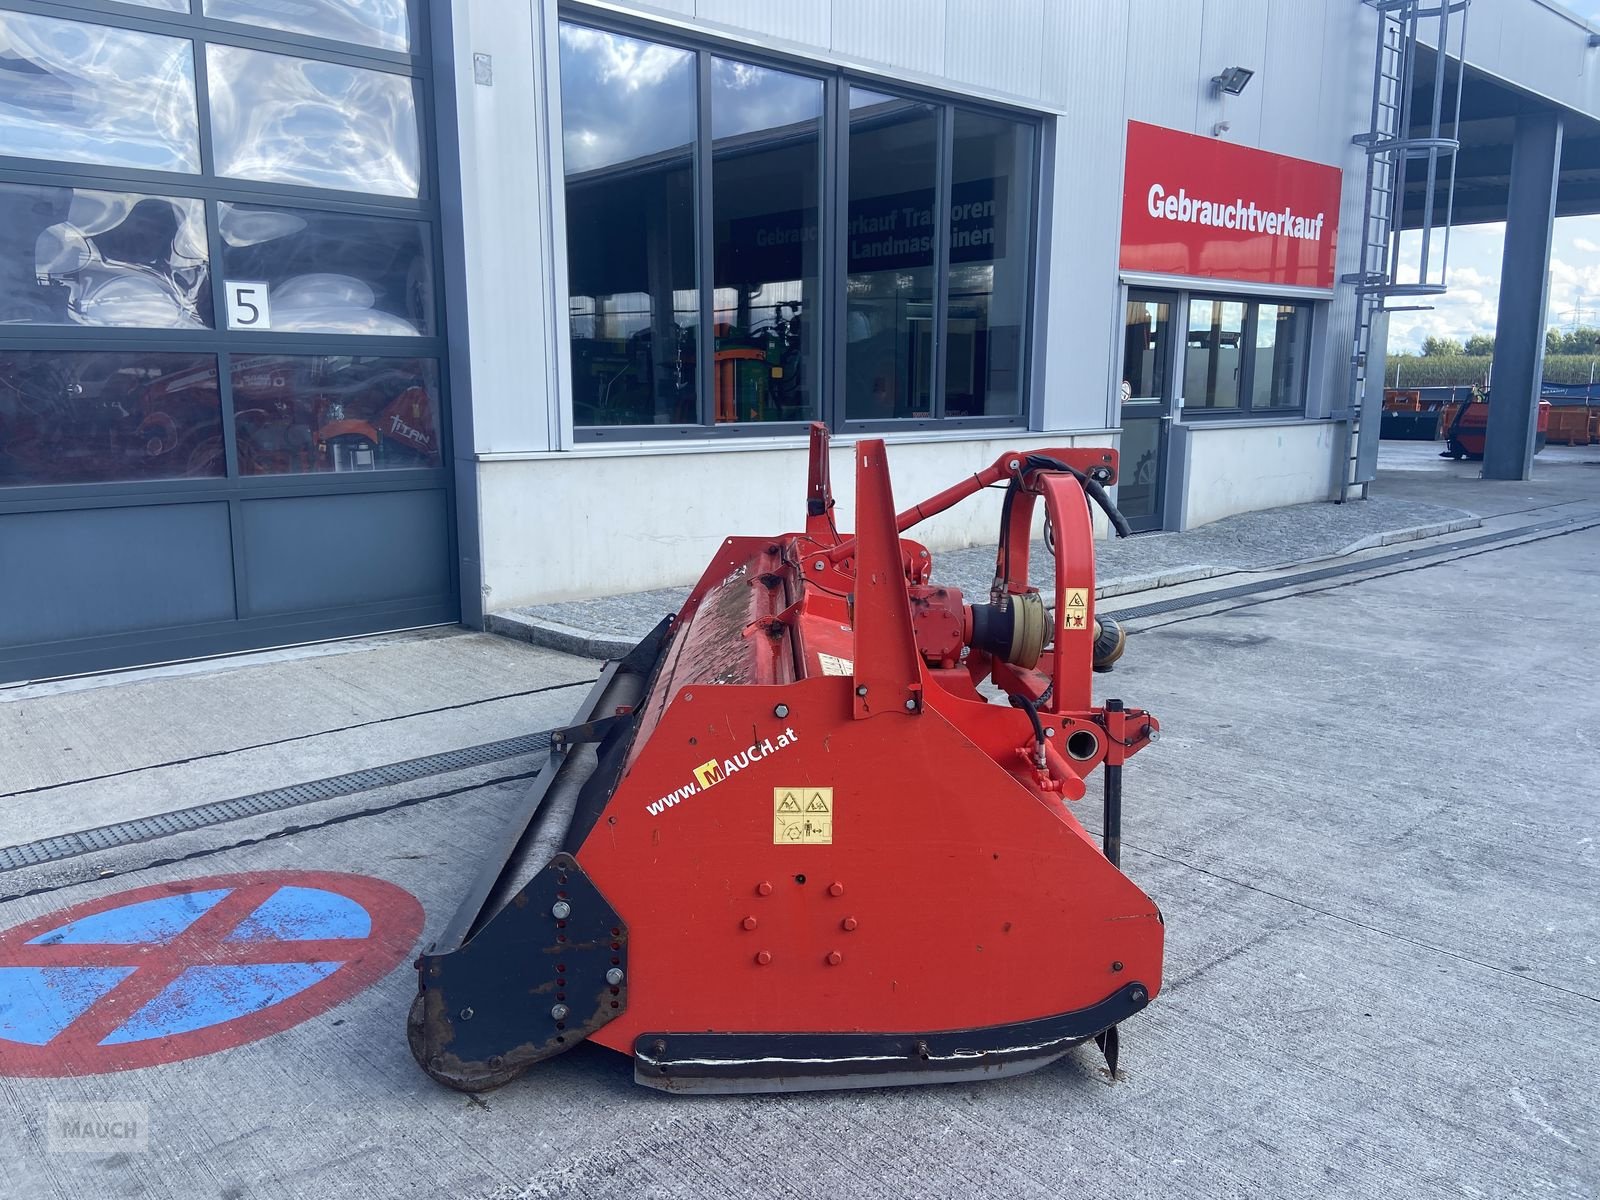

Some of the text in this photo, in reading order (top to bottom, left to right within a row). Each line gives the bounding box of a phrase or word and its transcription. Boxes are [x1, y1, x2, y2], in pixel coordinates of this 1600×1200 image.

[1147, 183, 1323, 240] Gebrauchtverkauf
[236, 289, 259, 324] 5
[645, 727, 799, 816] www.MAUCH.at
